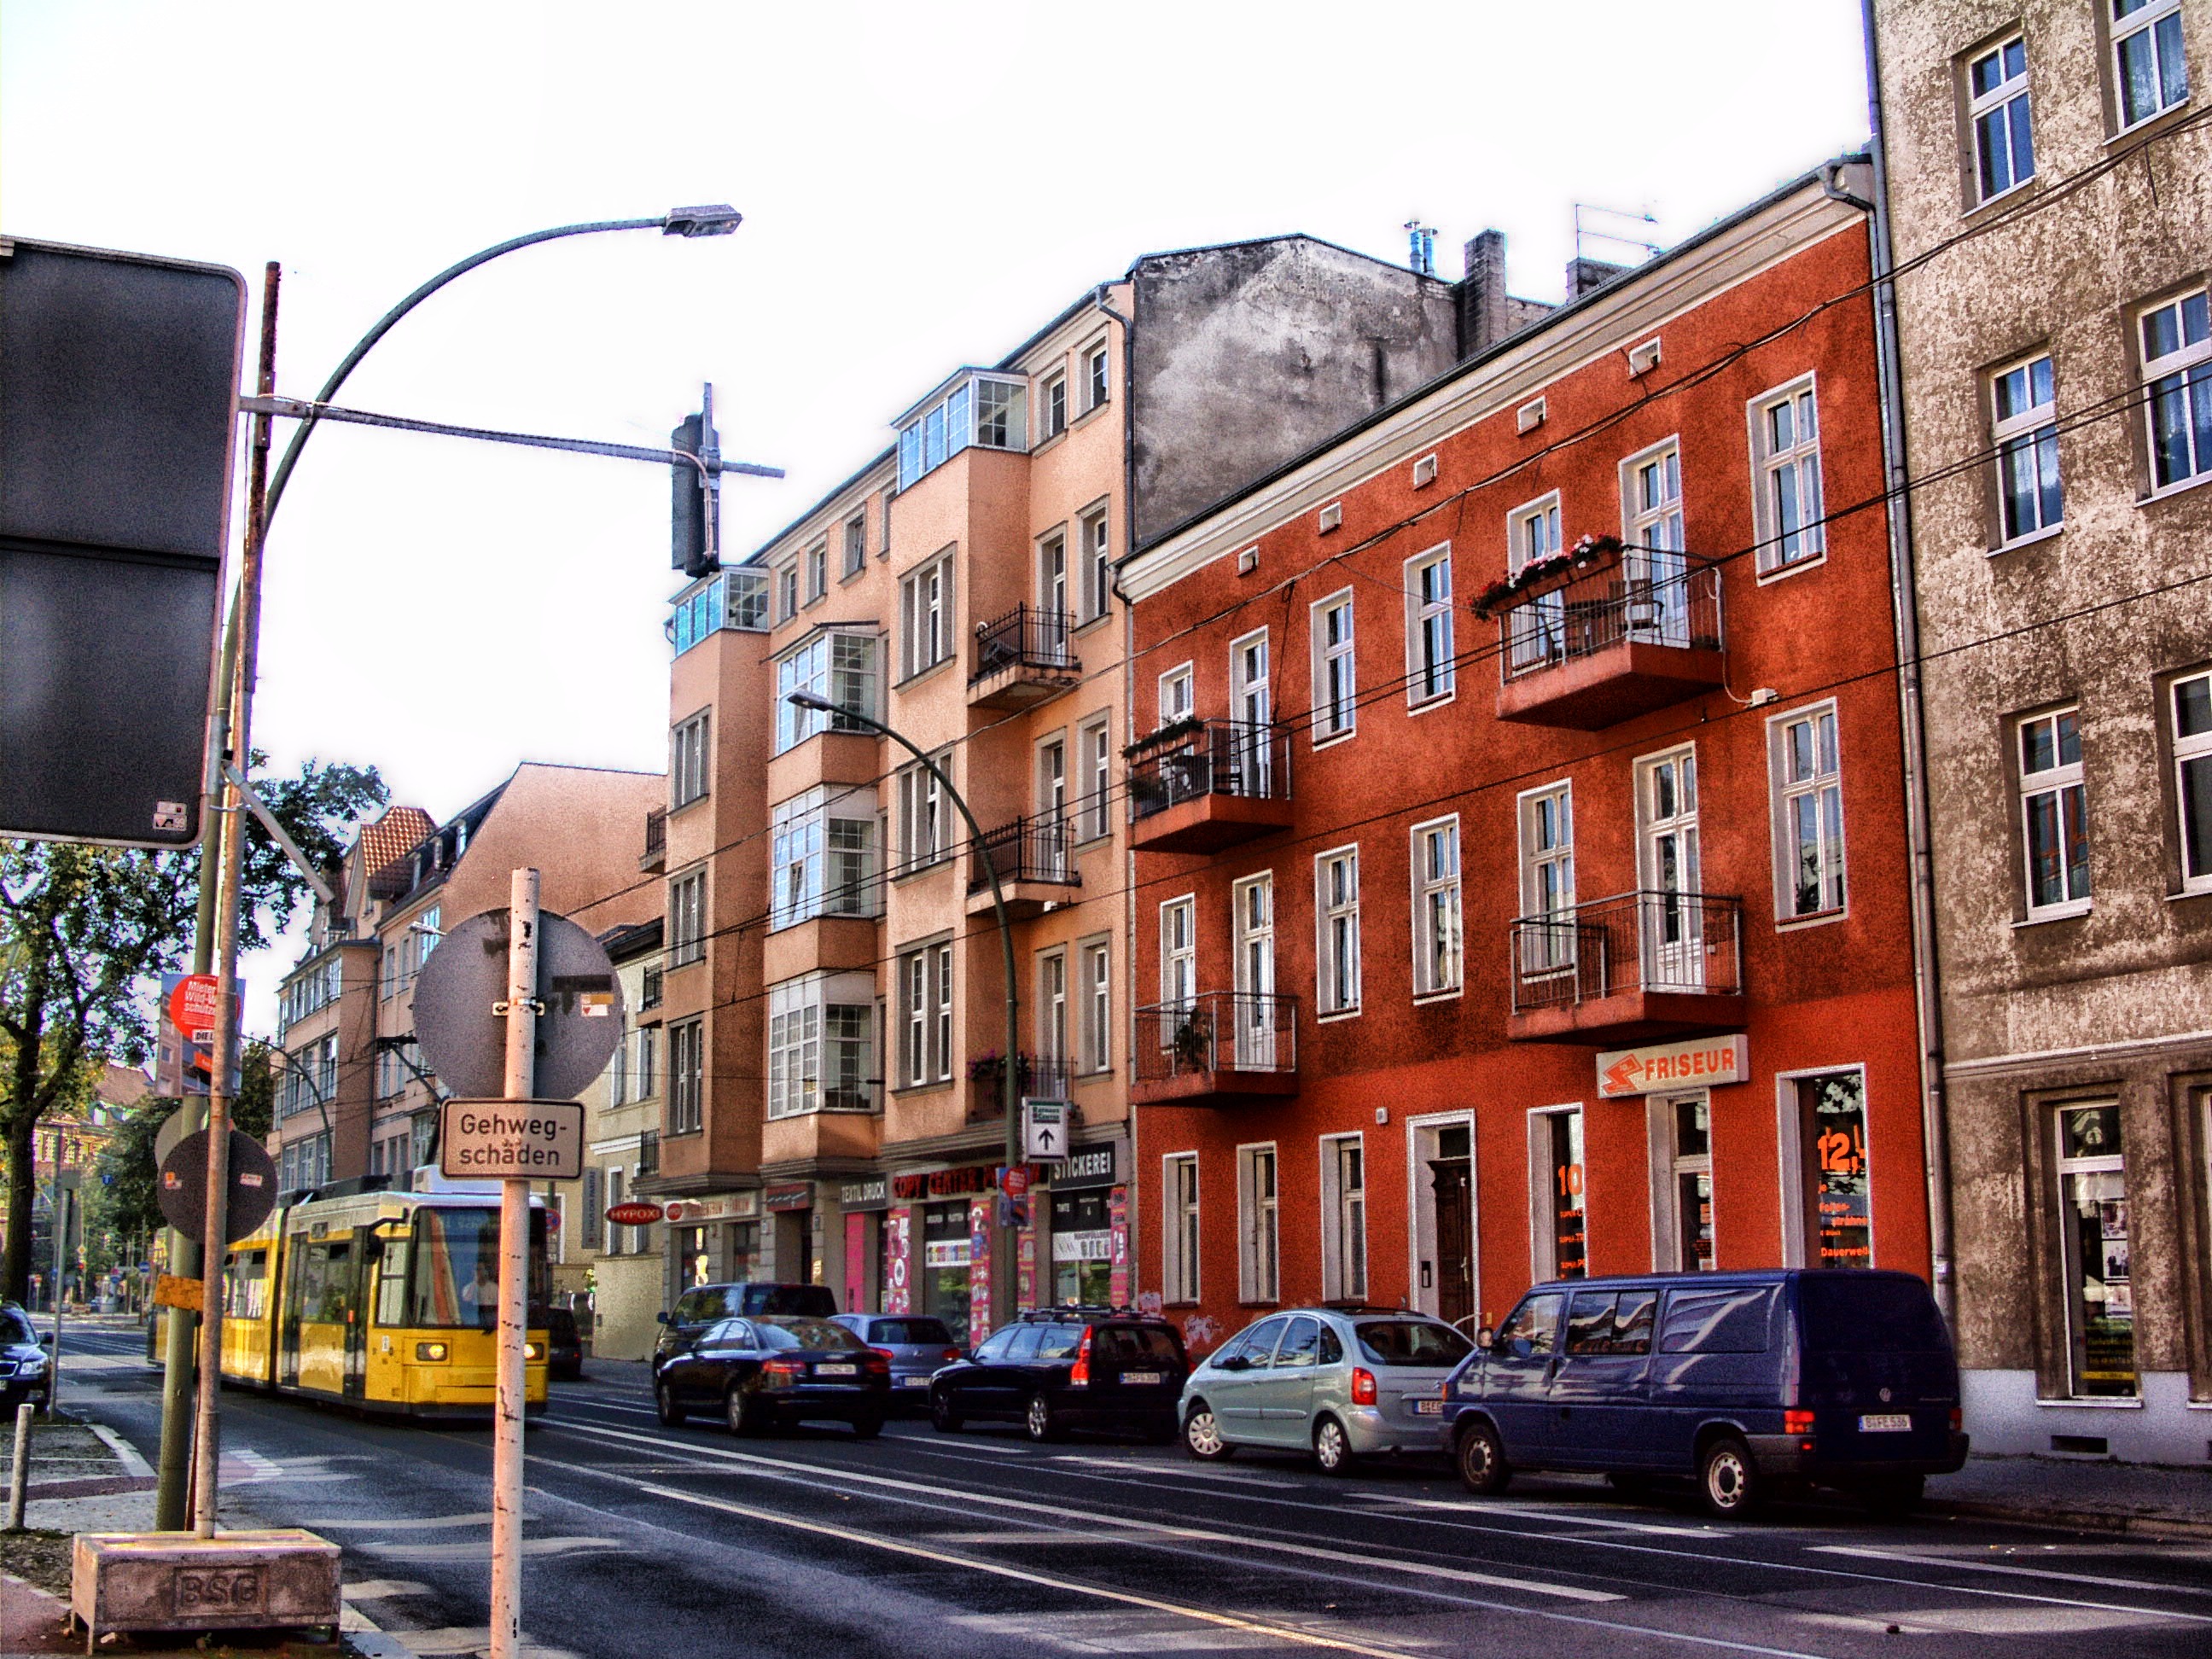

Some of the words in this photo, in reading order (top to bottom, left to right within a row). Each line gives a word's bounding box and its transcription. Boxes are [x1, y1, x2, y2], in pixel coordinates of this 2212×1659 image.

[1645, 1048, 1734, 1081] FRISEUR
[461, 1114, 568, 1141] Gehweg-
[459, 1142, 560, 1166] schäden
[1054, 1151, 1111, 1180] STICKEREI
[841, 1185, 862, 1203] TEXTIL
[863, 1181, 886, 1201] DRUCK
[893, 1174, 922, 1198] COPY
[929, 1167, 978, 1195] CENTER
[609, 1209, 661, 1220] HYPOXI
[1820, 1246, 1870, 1257] Dauerwell
